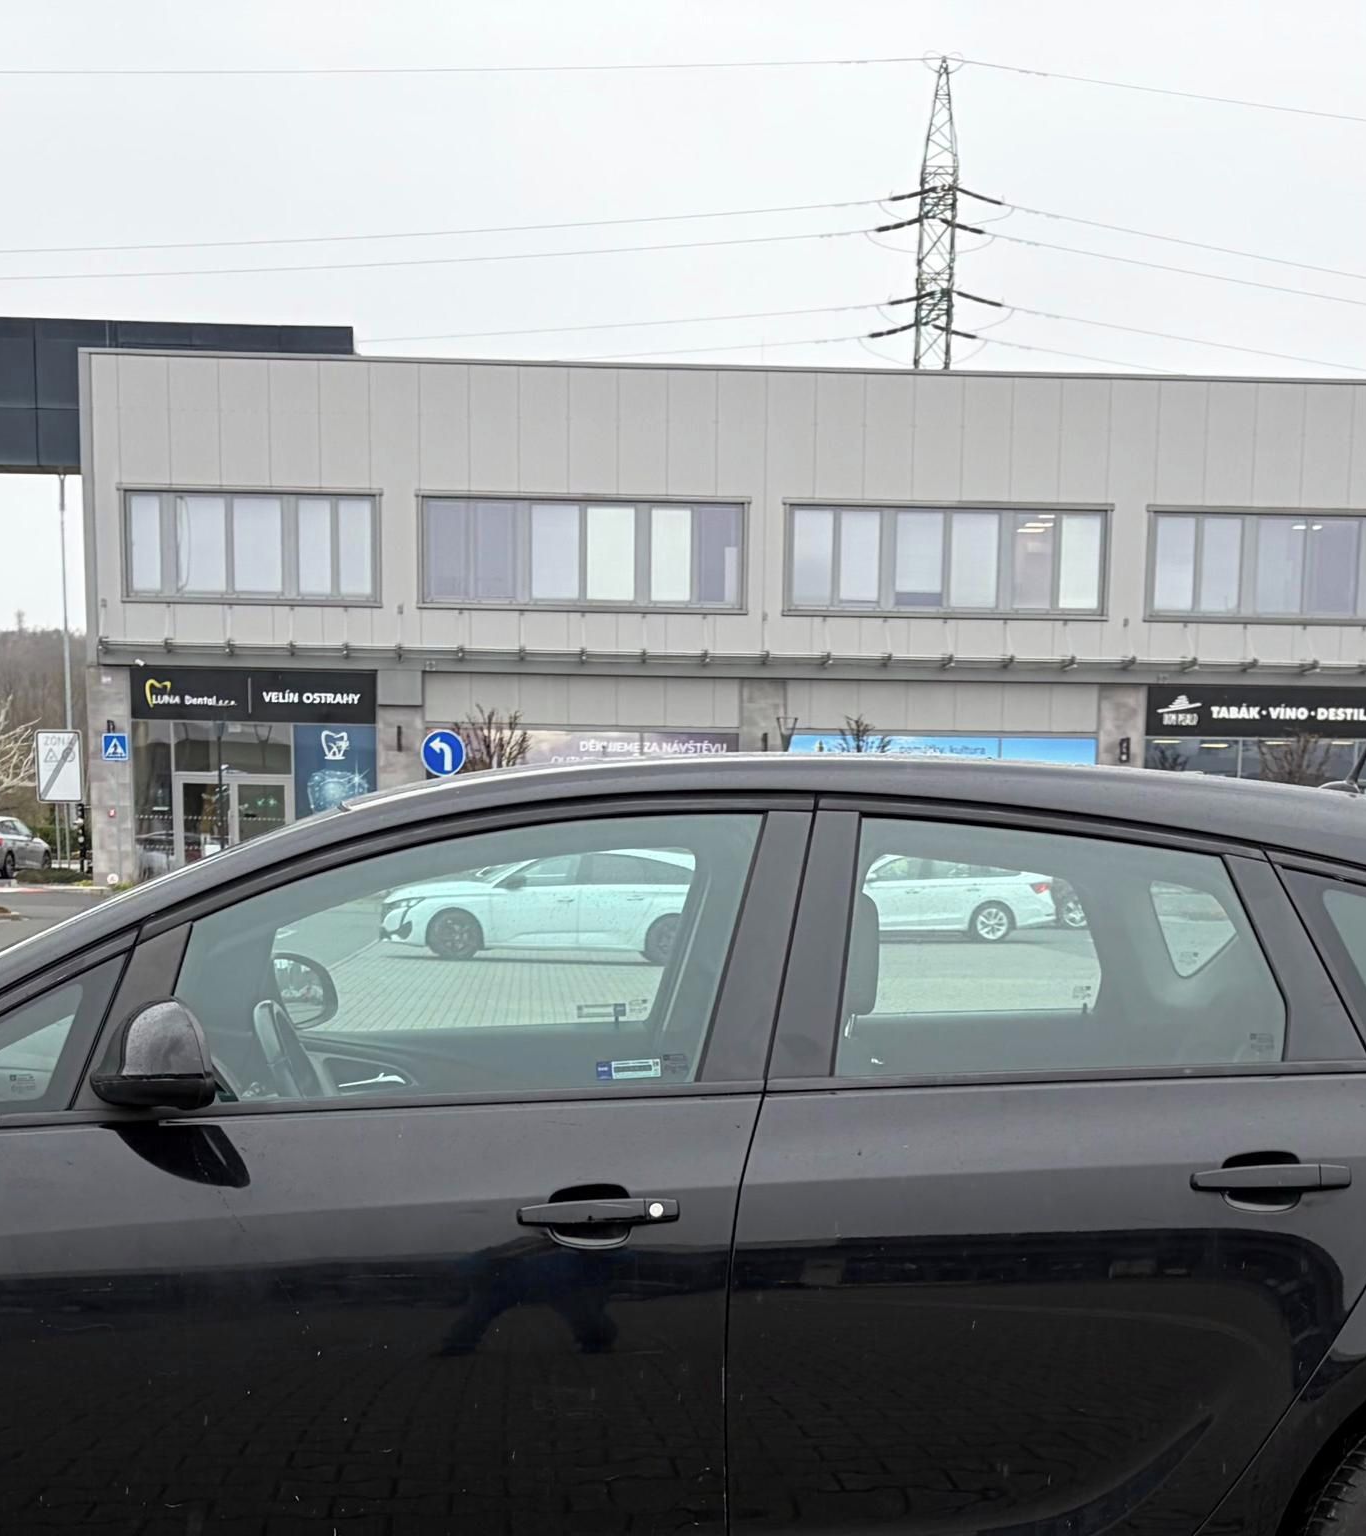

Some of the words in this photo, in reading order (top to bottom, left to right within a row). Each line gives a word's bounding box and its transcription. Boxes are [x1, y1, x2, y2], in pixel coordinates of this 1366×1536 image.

[184, 695, 216, 705] Dental
[263, 689, 299, 704] VELÍN
[302, 692, 361, 705] OSTRAHY
[1210, 703, 1261, 720] TABÁK
[1270, 703, 1309, 720] VÍNO
[642, 741, 660, 753] ZA
[662, 739, 727, 754] NÁVŠTĚVU
